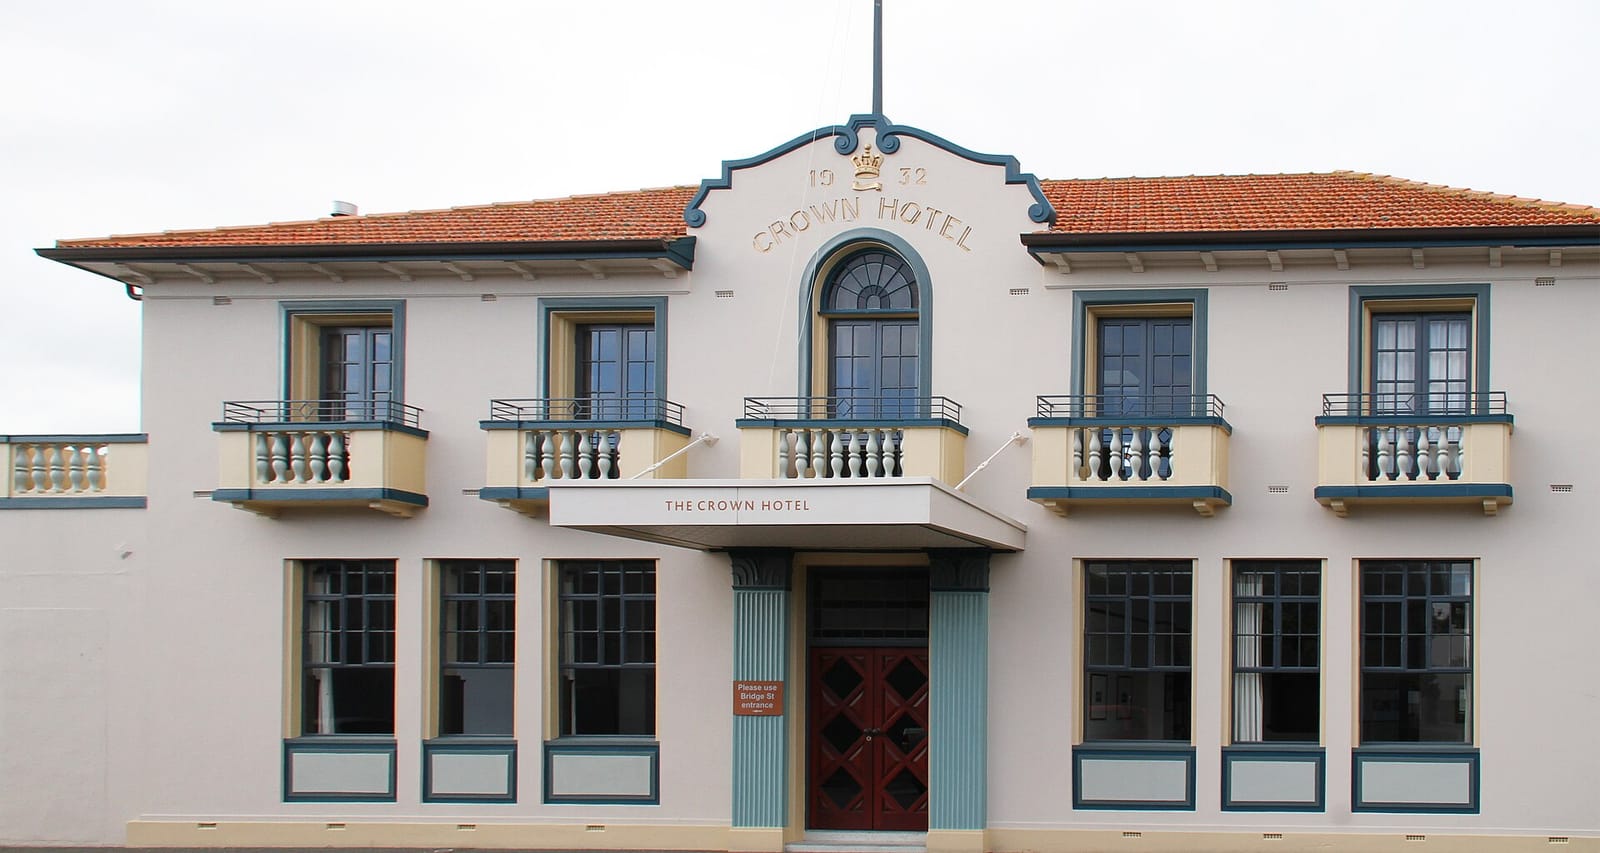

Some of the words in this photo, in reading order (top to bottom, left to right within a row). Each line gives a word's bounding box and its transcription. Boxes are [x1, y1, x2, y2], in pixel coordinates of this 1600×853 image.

[898, 167, 928, 187] 32
[752, 196, 860, 254] CROWN
[878, 196, 973, 253] HOTEL
[665, 500, 693, 511] THE
[697, 500, 754, 511] CROWN
[761, 500, 810, 511] HOTEL
[737, 683, 762, 691] Please
[740, 692, 765, 701] Bridge
[766, 692, 775, 700] St
